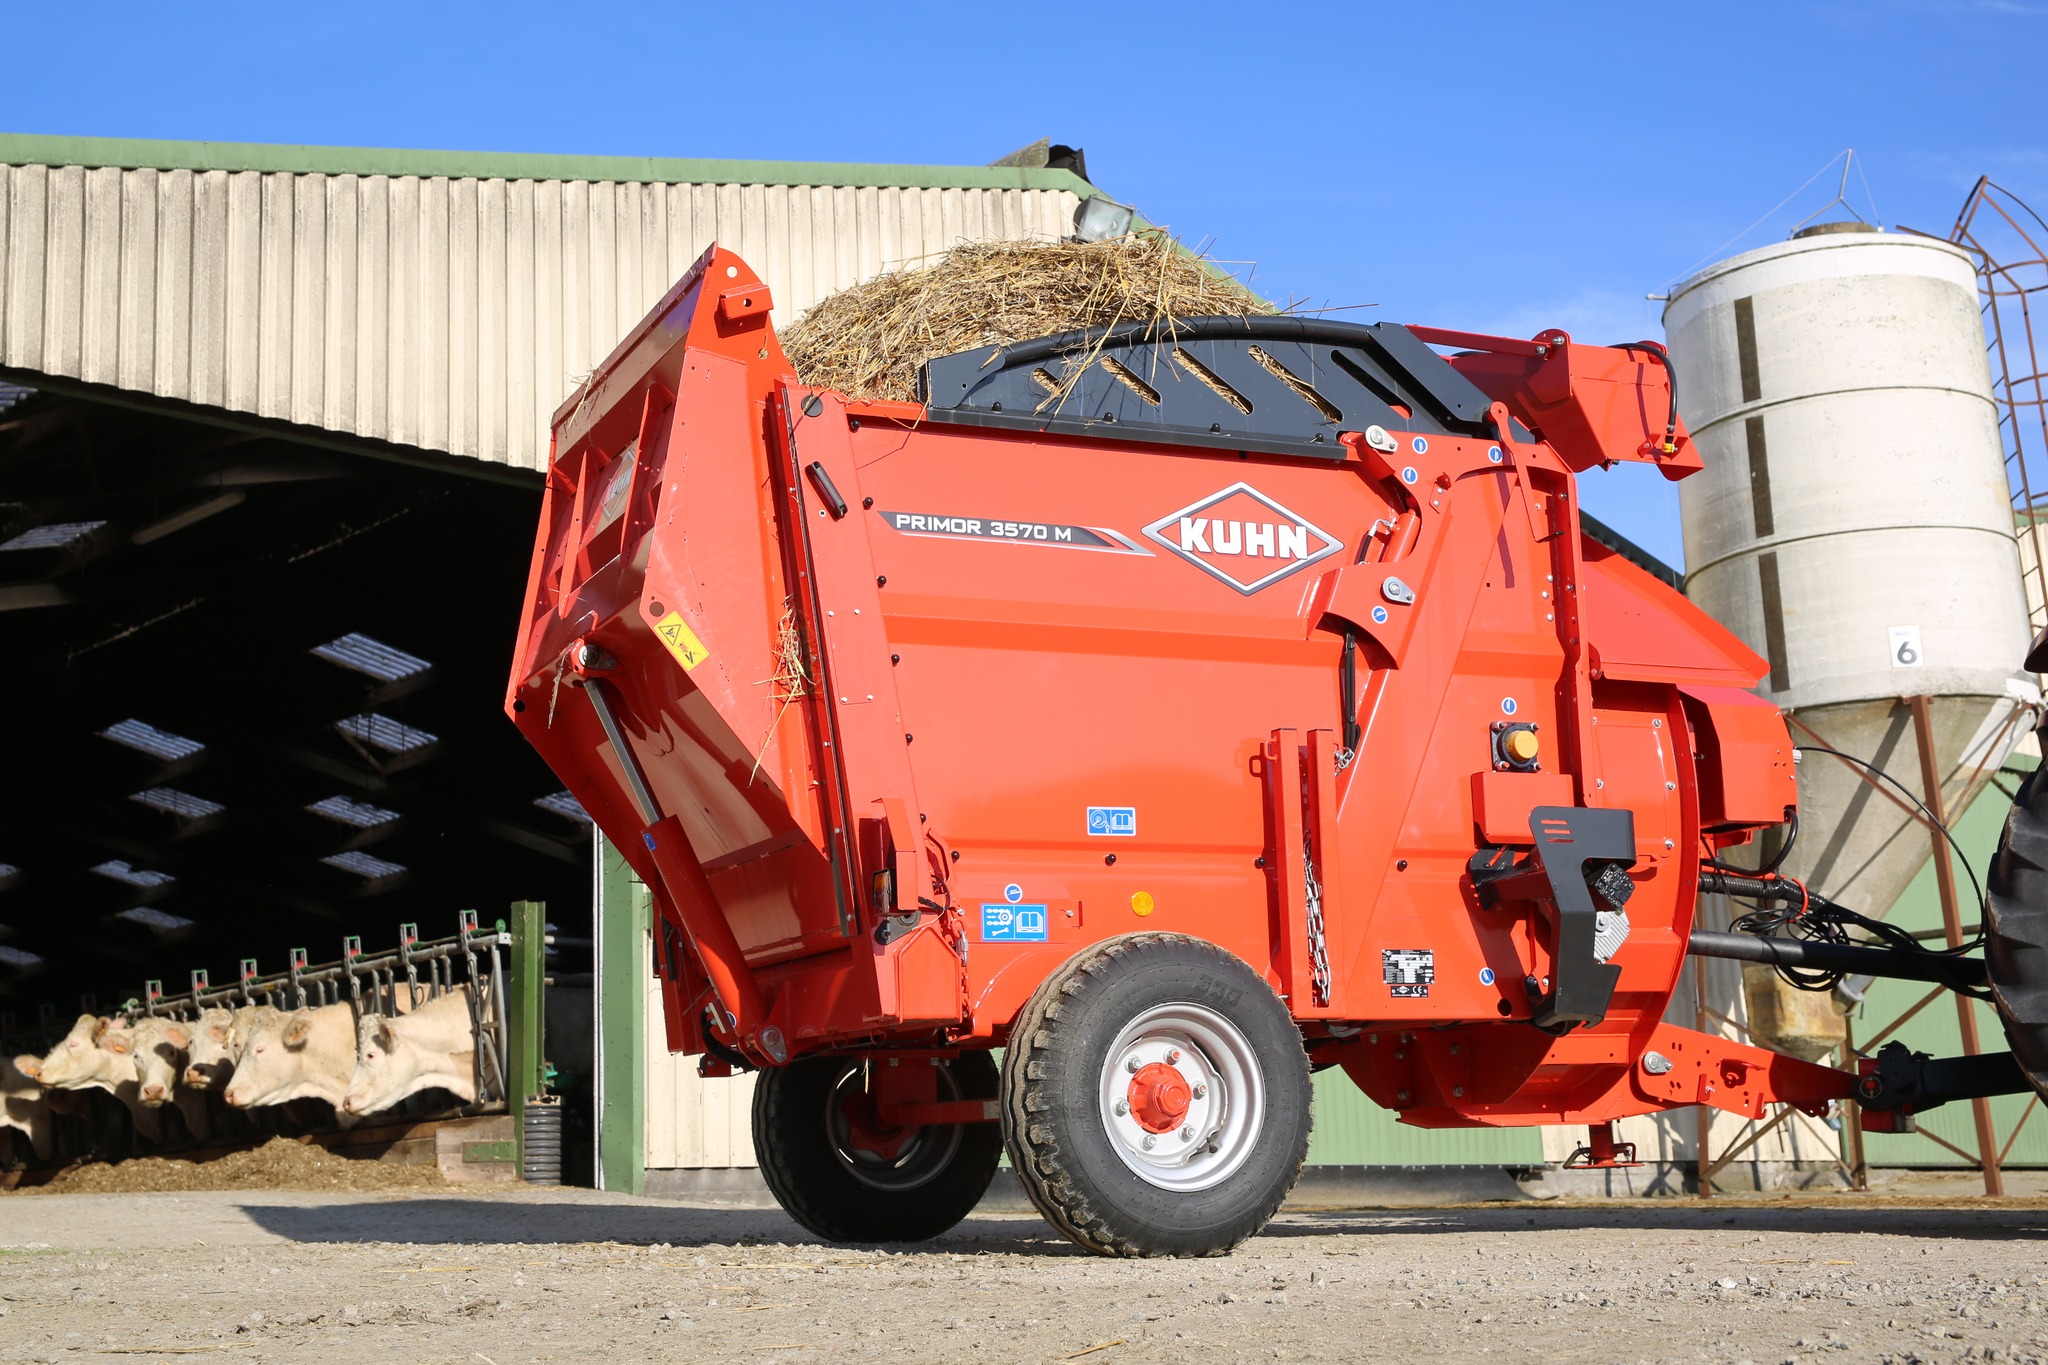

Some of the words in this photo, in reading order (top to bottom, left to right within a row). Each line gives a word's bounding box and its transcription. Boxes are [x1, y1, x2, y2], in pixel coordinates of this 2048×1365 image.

[896, 514, 983, 535] PRIMOR
[990, 521, 1048, 540] 3570
[1054, 526, 1072, 542] M
[1179, 516, 1308, 560] KUHN
[1897, 640, 1918, 665] 6
